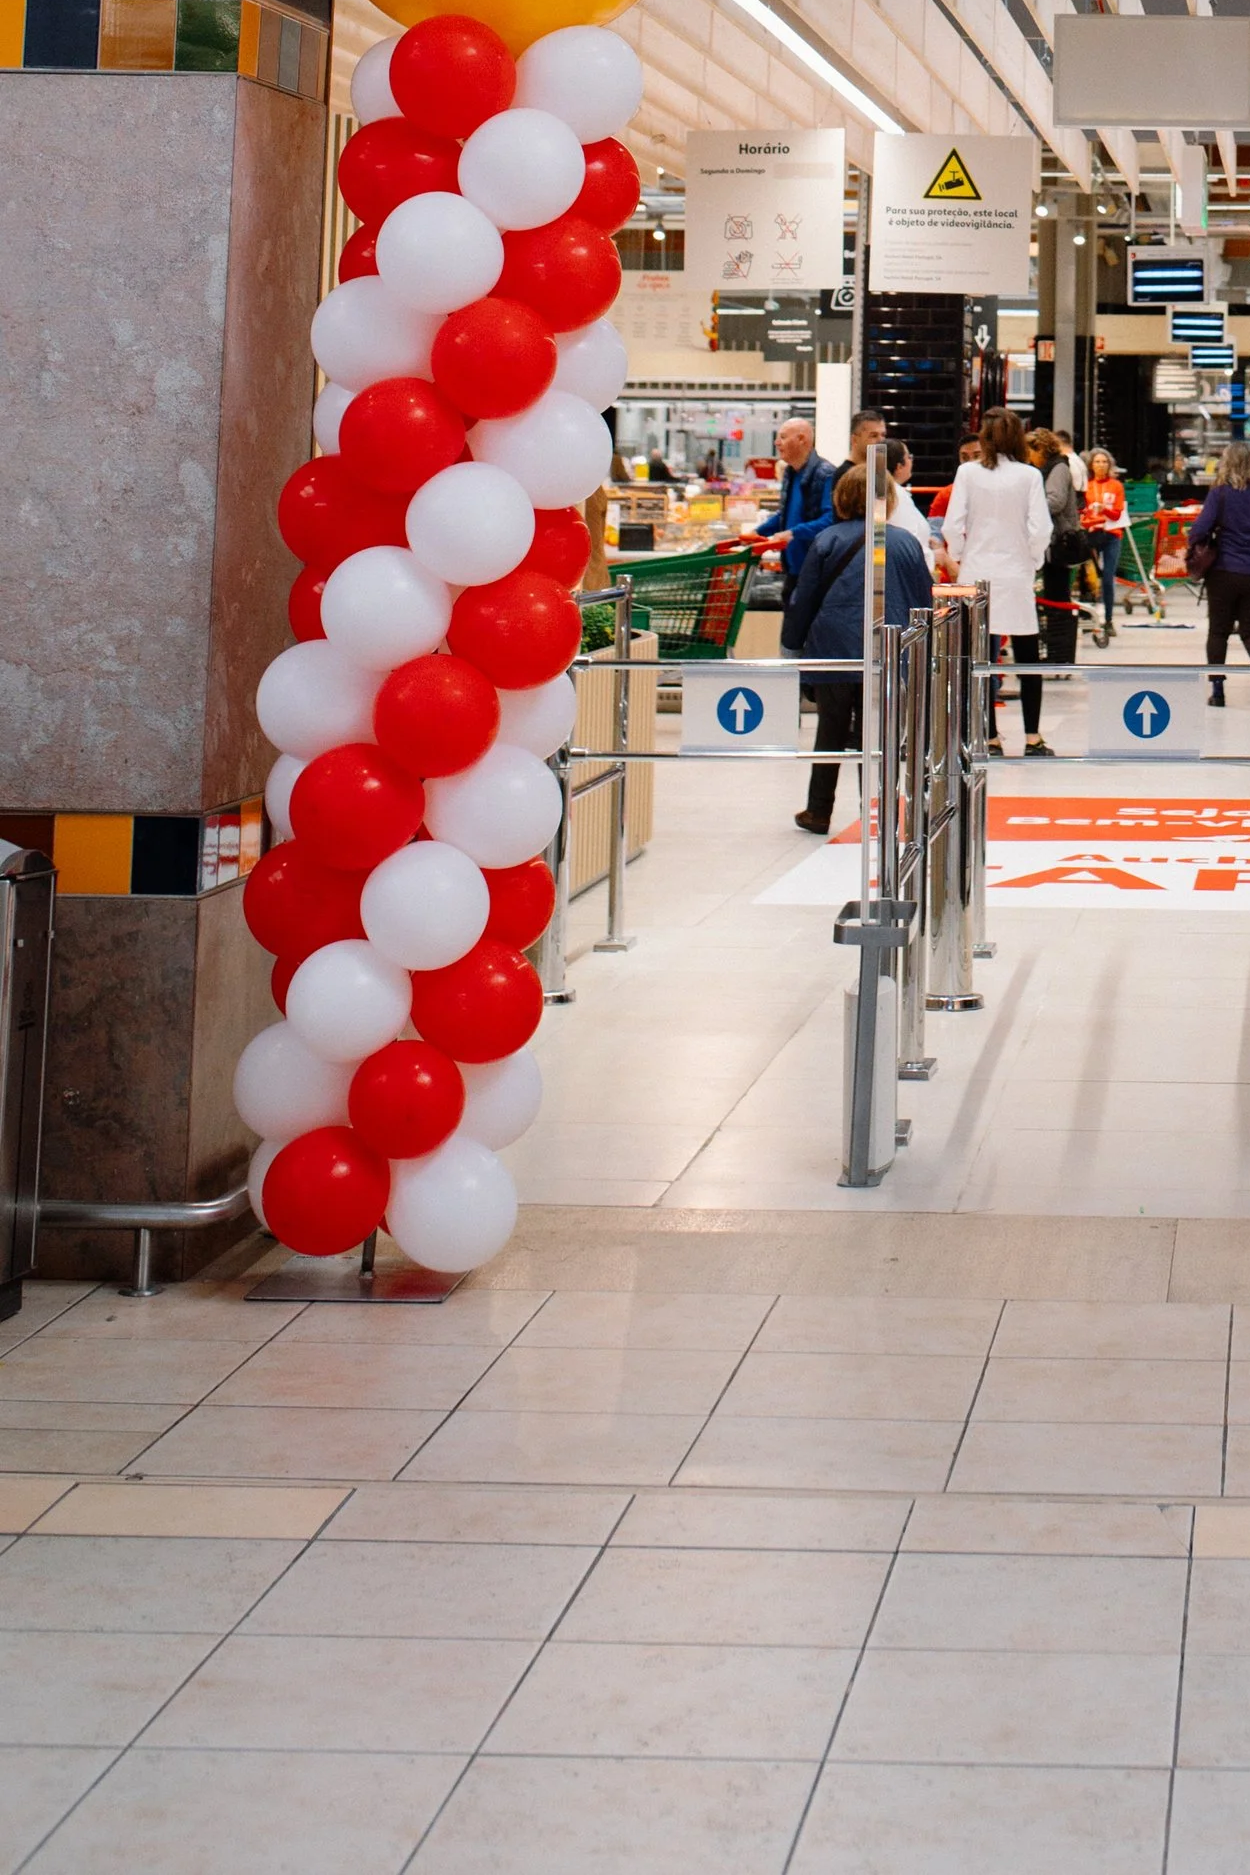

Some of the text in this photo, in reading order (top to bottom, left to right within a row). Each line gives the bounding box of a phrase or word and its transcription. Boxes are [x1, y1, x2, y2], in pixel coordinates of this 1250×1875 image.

[739, 142, 790, 154] Horário
[886, 206, 907, 215] Para
[927, 207, 971, 218] proteção,
[973, 209, 992, 217] este
[994, 208, 1018, 218] local
[888, 218, 1014, 230] é objeto de videovigilância.
